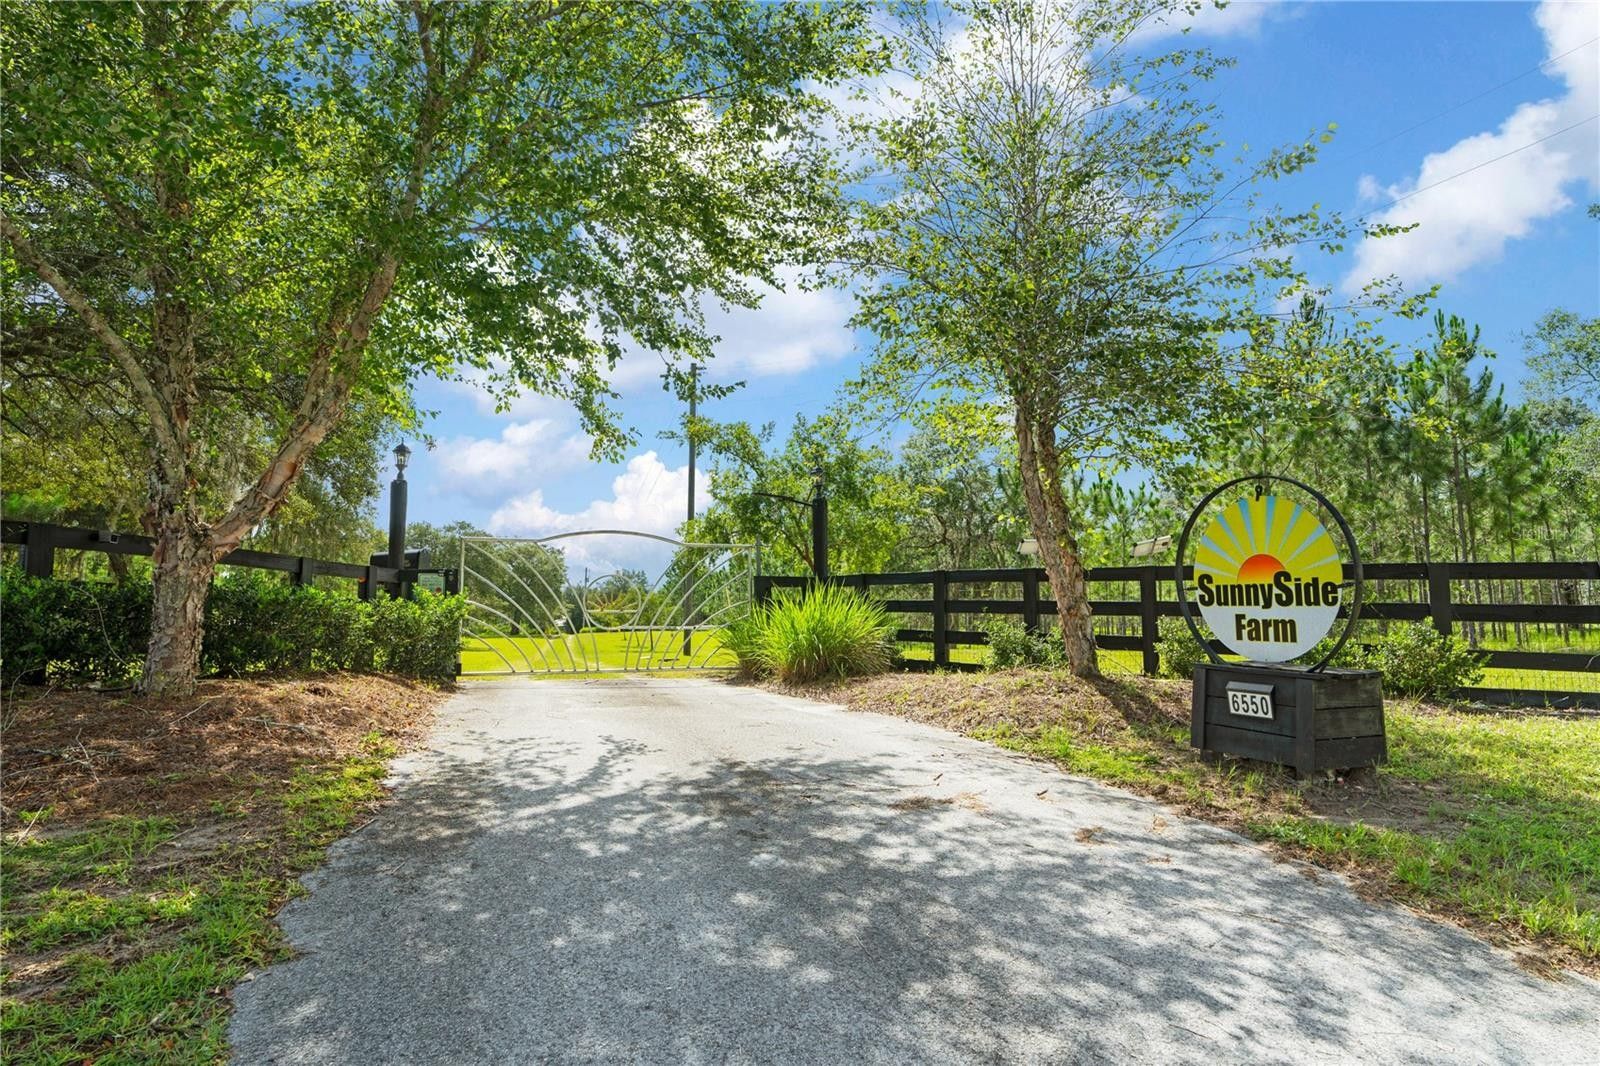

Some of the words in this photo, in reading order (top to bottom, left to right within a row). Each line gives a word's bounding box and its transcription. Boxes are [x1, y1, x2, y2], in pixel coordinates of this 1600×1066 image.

[1198, 570, 1338, 609] SunnySide
[1235, 614, 1297, 643] Farm
[1232, 693, 1269, 716] 6550
